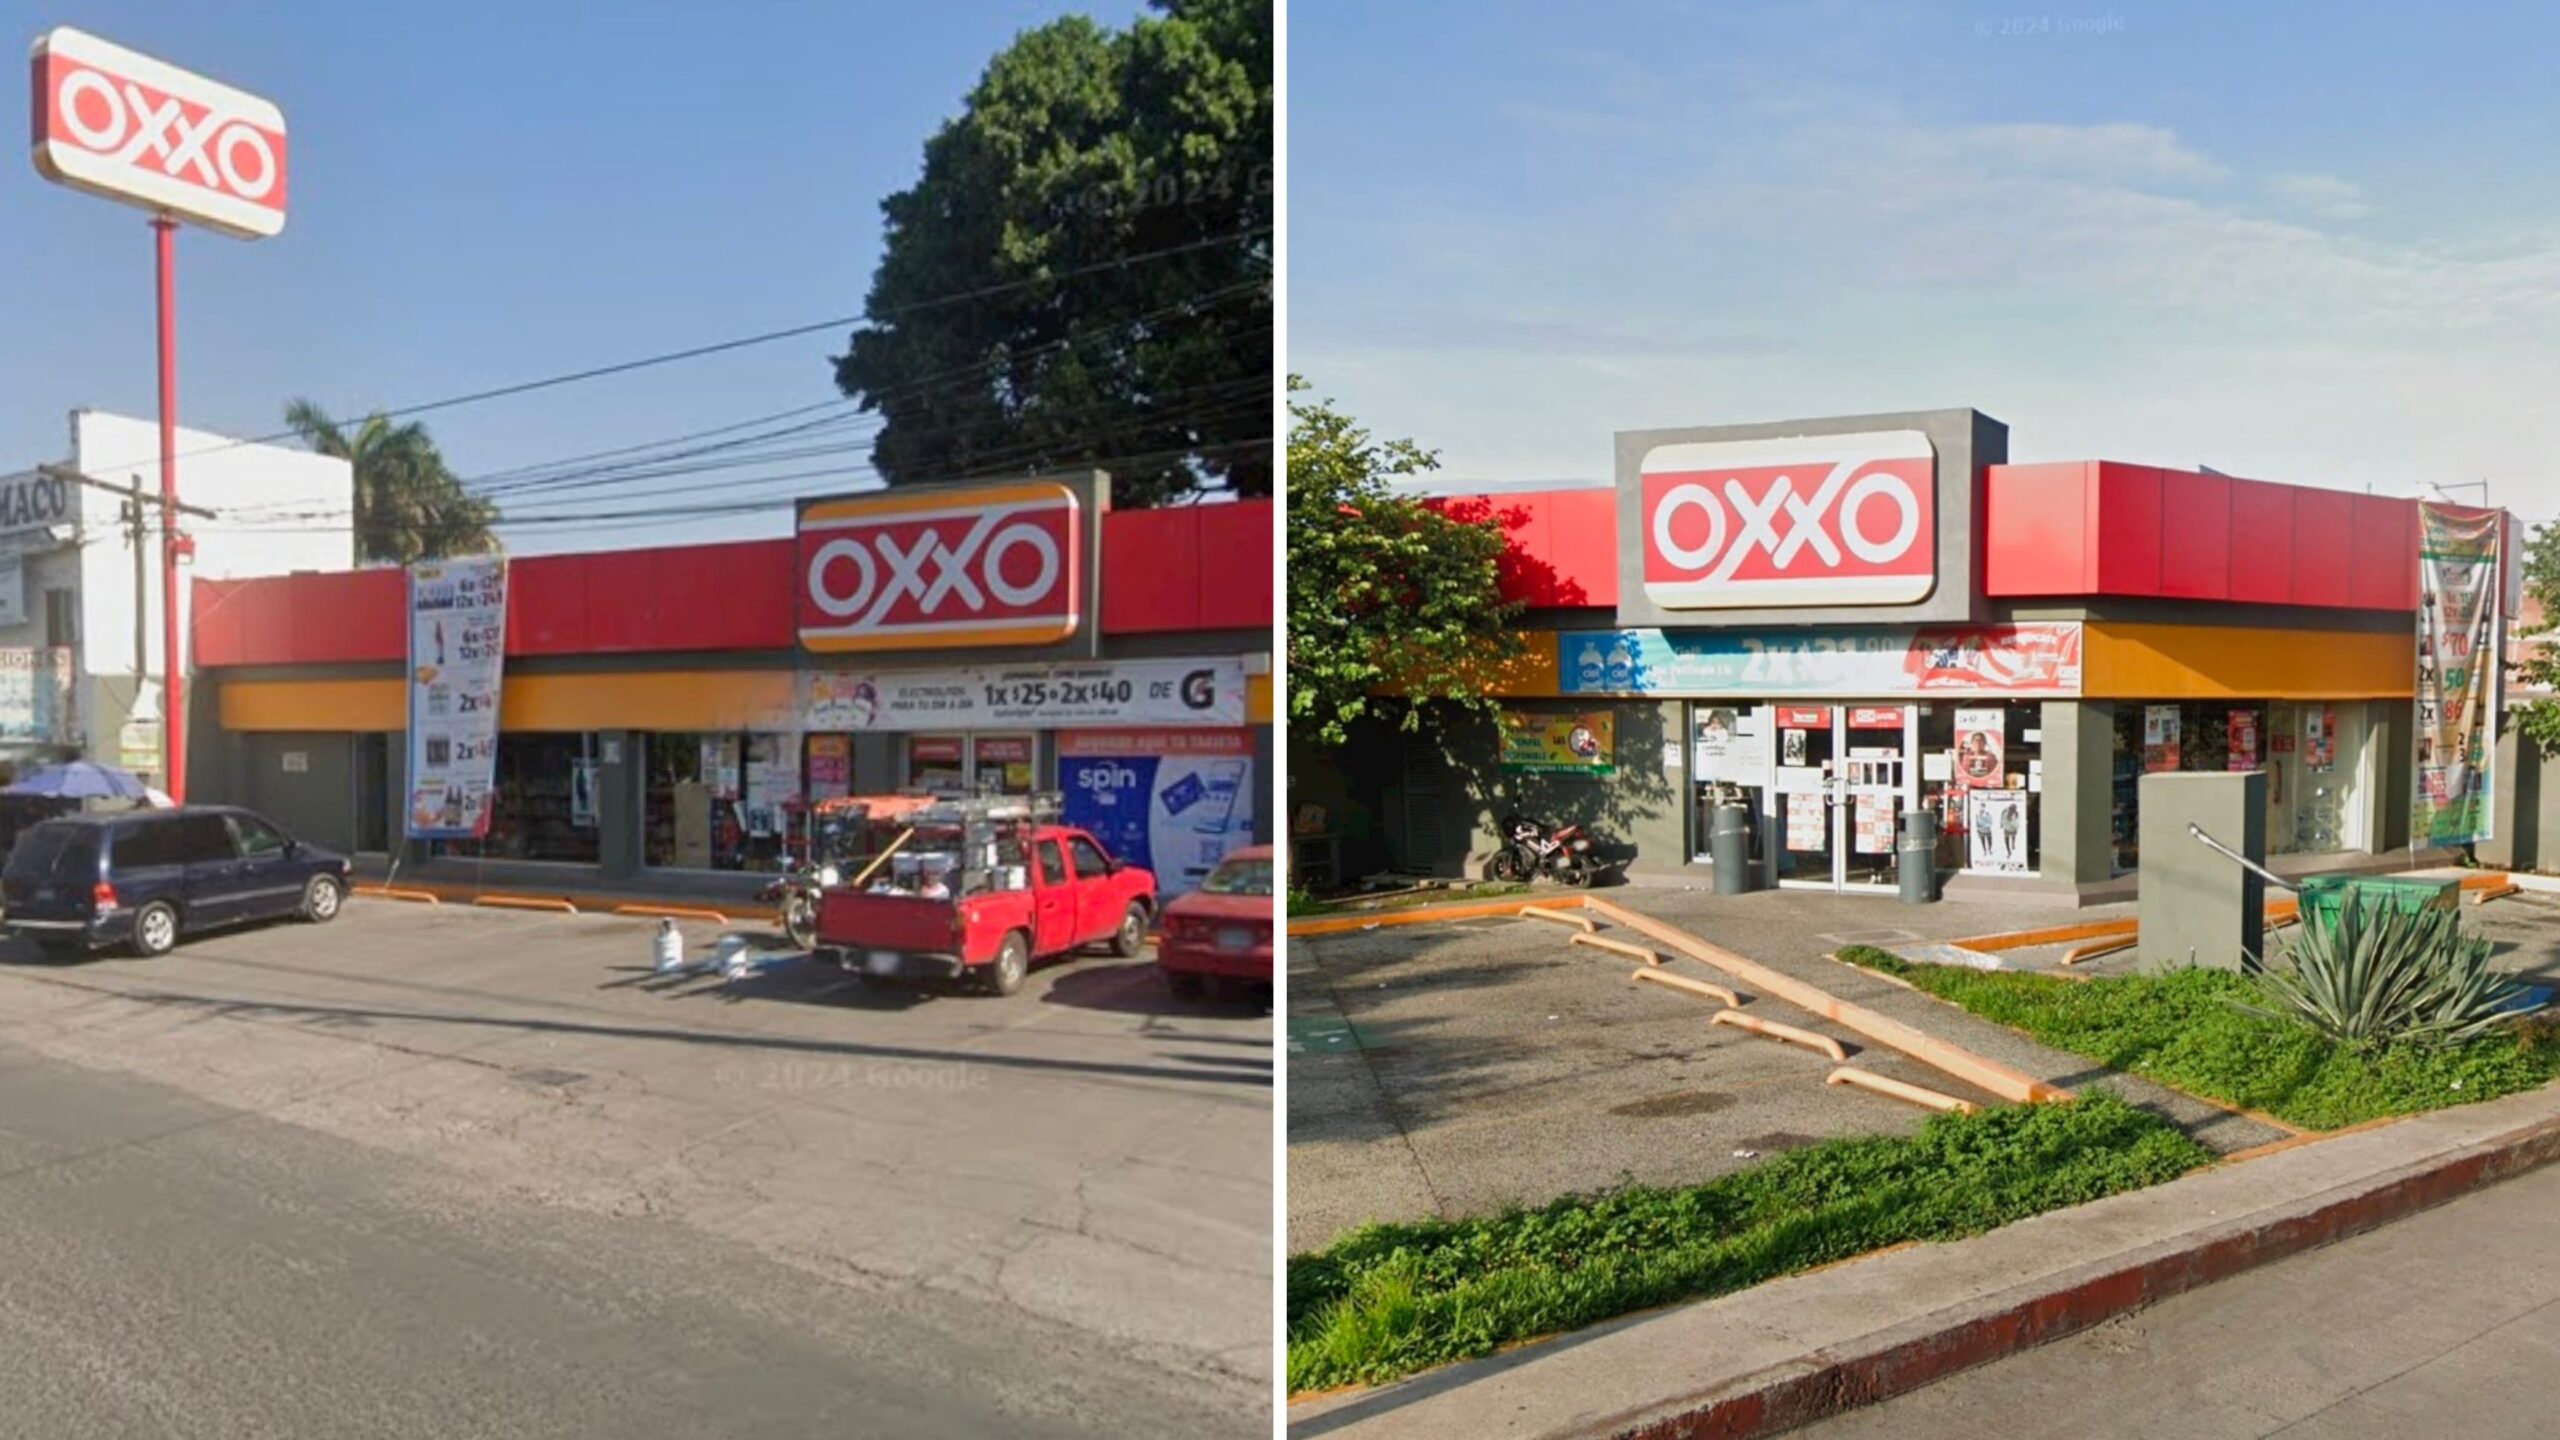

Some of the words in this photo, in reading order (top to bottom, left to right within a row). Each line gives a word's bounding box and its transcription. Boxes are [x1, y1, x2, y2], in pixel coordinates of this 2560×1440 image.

[59, 69, 276, 200] OXXO
[1653, 461, 1920, 579] OXXO
[808, 511, 1060, 628] OXXO
[2419, 665, 2434, 682] 2x
[984, 683, 1008, 706] 1x
[1012, 682, 1046, 706] $25
[1060, 682, 1089, 705] 2x
[1091, 680, 1133, 704] $40
[1149, 681, 1174, 700] DE
[2420, 705, 2433, 721] 2x
[1078, 763, 1136, 794] spin
